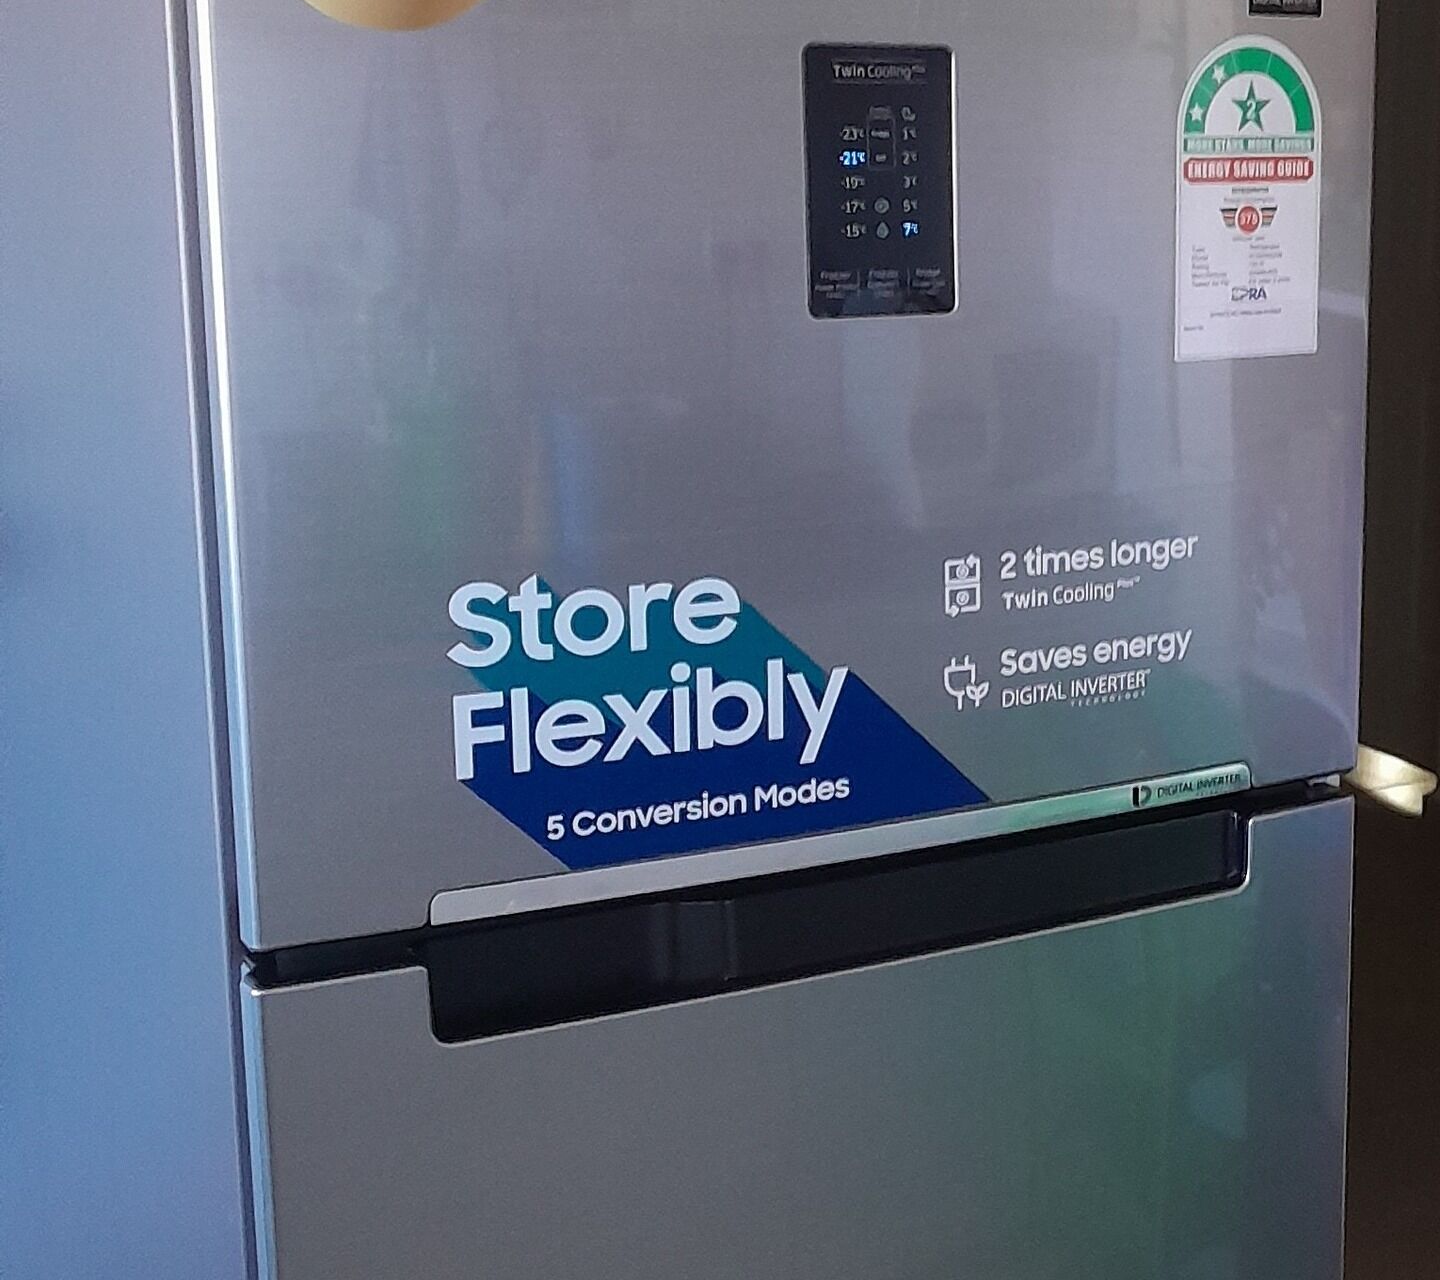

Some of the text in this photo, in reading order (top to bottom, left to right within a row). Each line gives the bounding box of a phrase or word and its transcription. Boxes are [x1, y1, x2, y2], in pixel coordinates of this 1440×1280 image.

[833, 63, 865, 79] Twin
[1188, 158, 1310, 179] ENERGY SAVING GUIDE
[1000, 535, 1199, 580] 2 times longer
[1002, 589, 1049, 610] Twin
[1053, 581, 1116, 605] Cooling
[446, 572, 740, 669] Store
[1000, 629, 1193, 677] Saves energy
[1002, 670, 1148, 709] DIGITAL INVERTER
[452, 658, 850, 781] Flexibly
[1157, 781, 1193, 799] DIGITAL
[1196, 773, 1241, 790] INVERTER
[546, 778, 850, 841] 5 Conversion Modes
